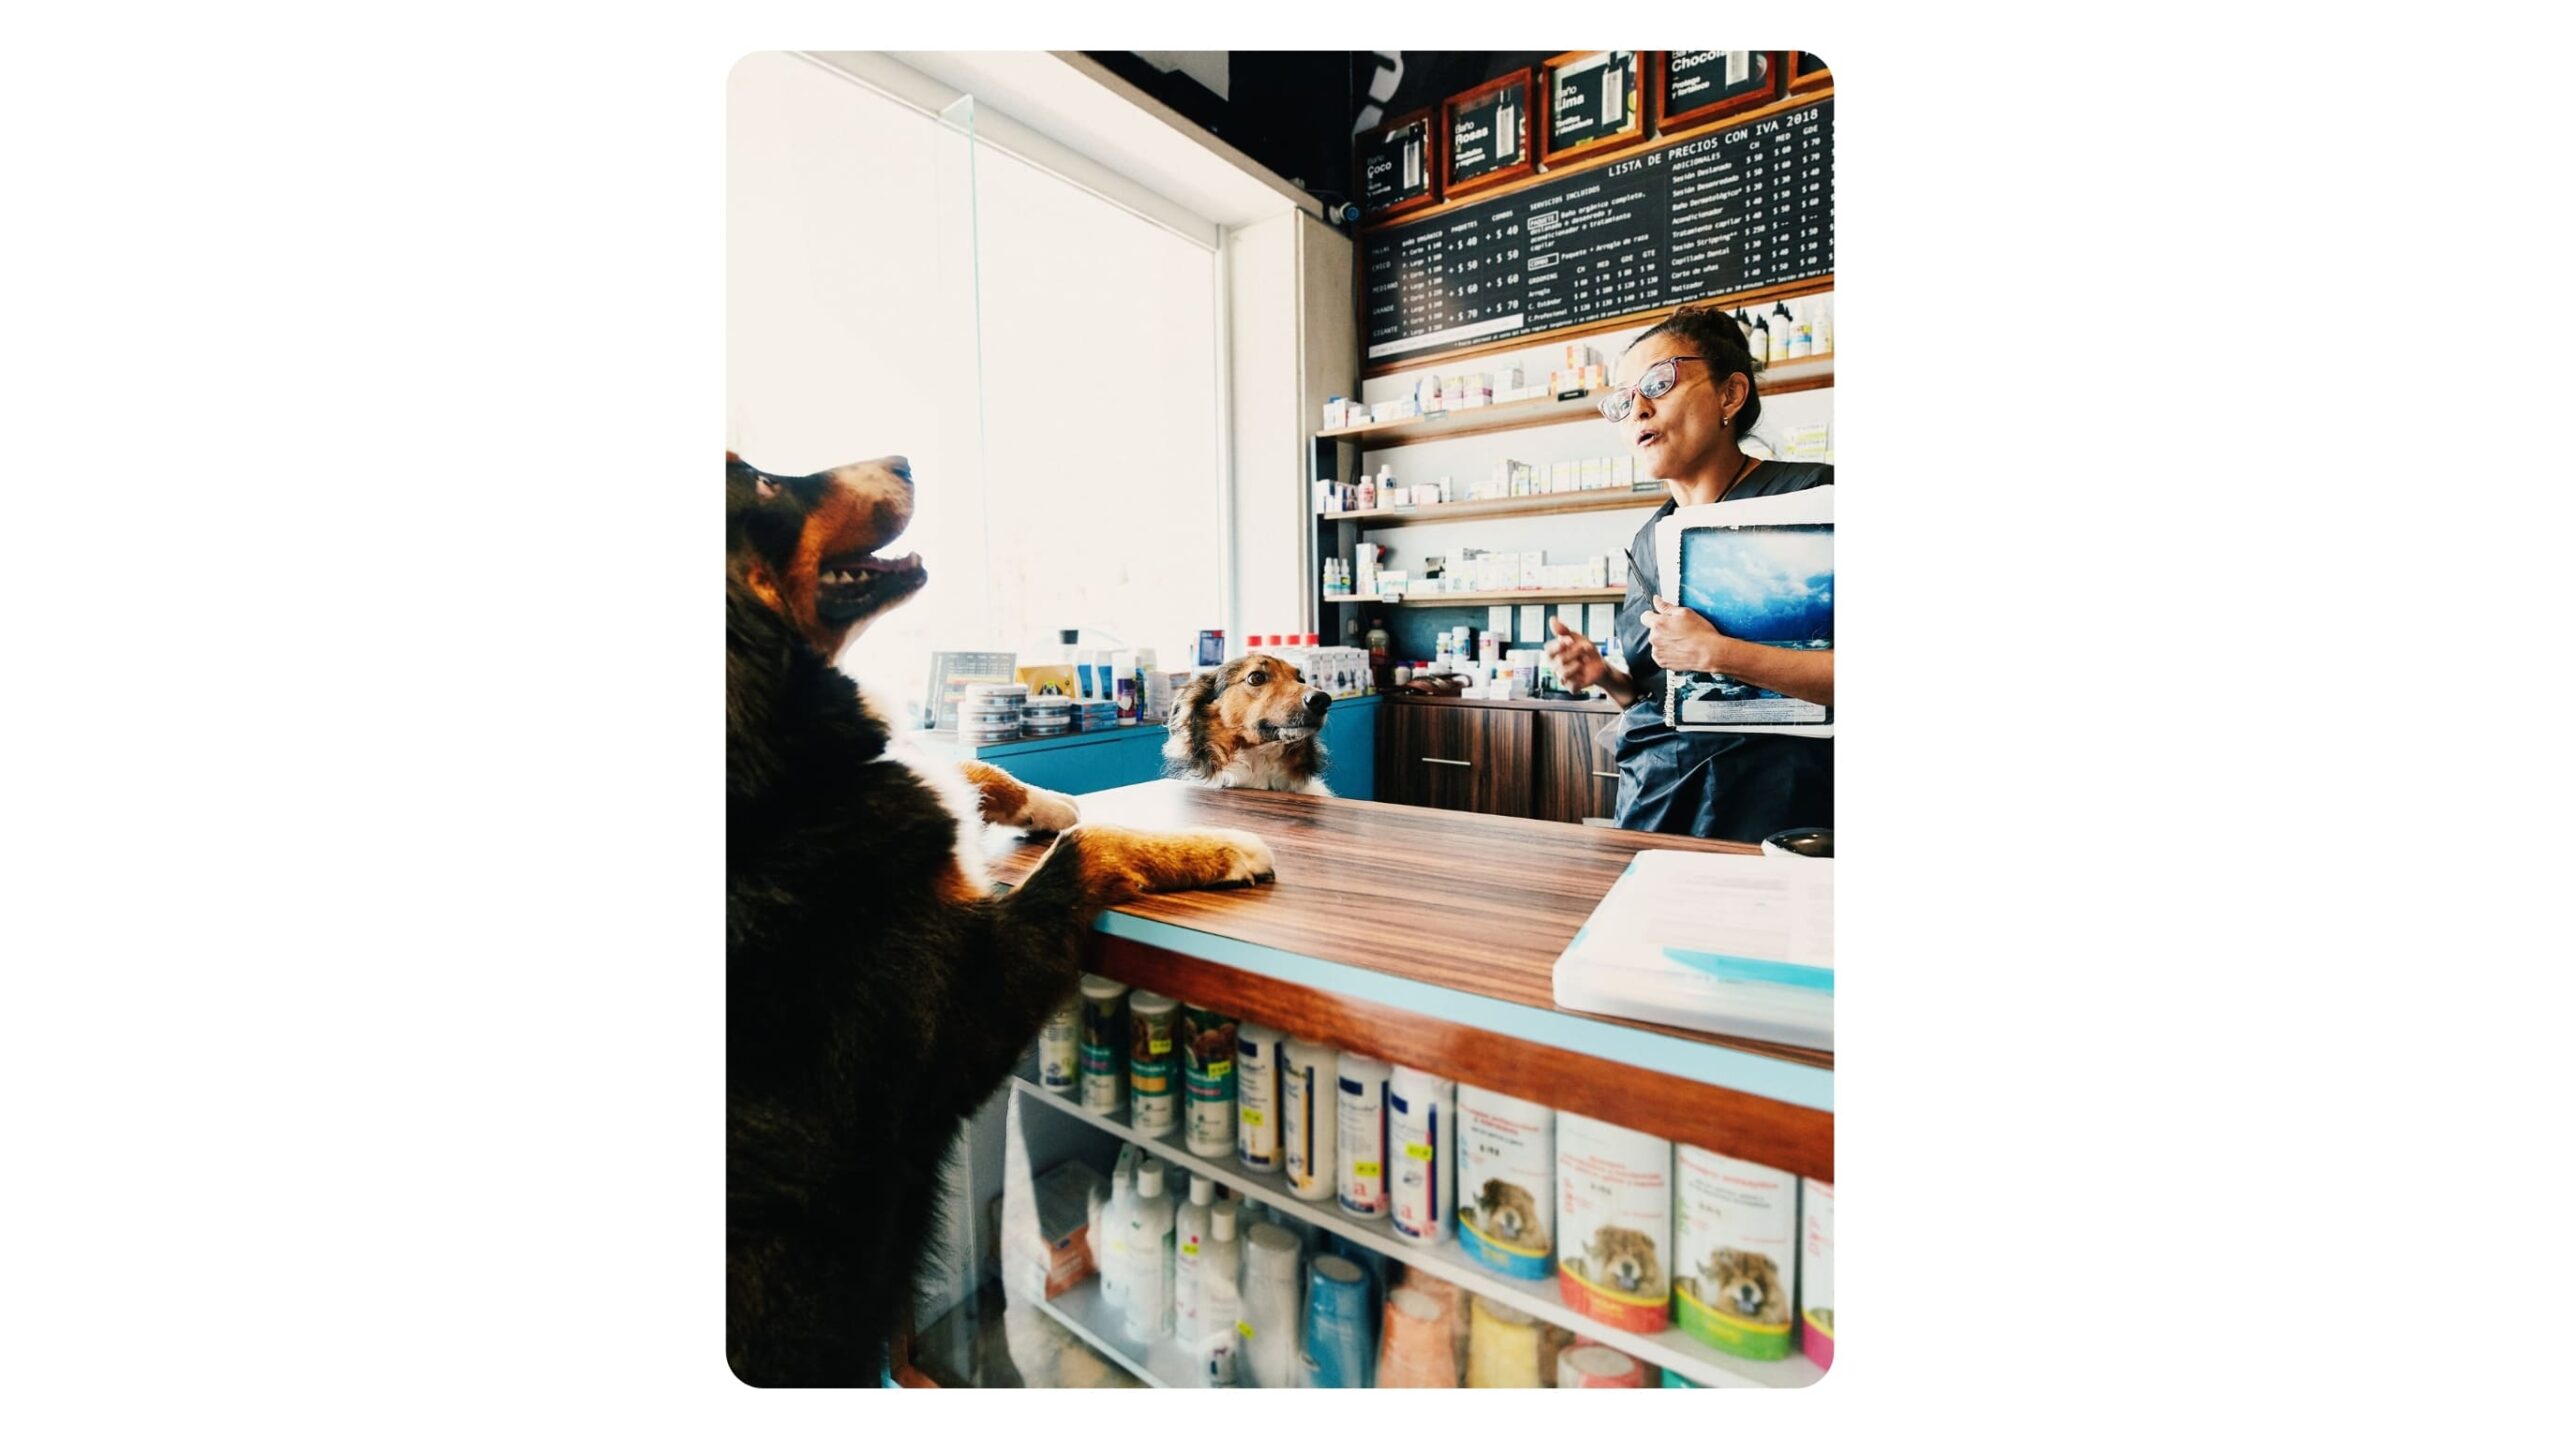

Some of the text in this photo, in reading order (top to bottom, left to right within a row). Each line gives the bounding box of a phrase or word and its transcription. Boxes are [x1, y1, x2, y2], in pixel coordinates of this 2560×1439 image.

[1609, 109, 1818, 177] LISTA DE PRECIOS CON IVA 2018
[1672, 152, 1720, 171] ADICIONALES
[1775, 132, 1791, 142] MED
[1368, 162, 1392, 176] Coco
[1530, 196, 1563, 211] SERVICIOS
[1467, 236, 1477, 246] 40
[1507, 225, 1519, 235] 40
[1672, 224, 1713, 238] Tratamiento
[1715, 217, 1741, 228] capilar
[1467, 260, 1478, 271] 50
[1507, 249, 1519, 260] 50
[1467, 283, 1478, 294] 60
[1507, 273, 1519, 284] 60
[1671, 270, 1690, 279] Corte
[1468, 309, 1478, 318] 70
[1508, 300, 1519, 310] 70
